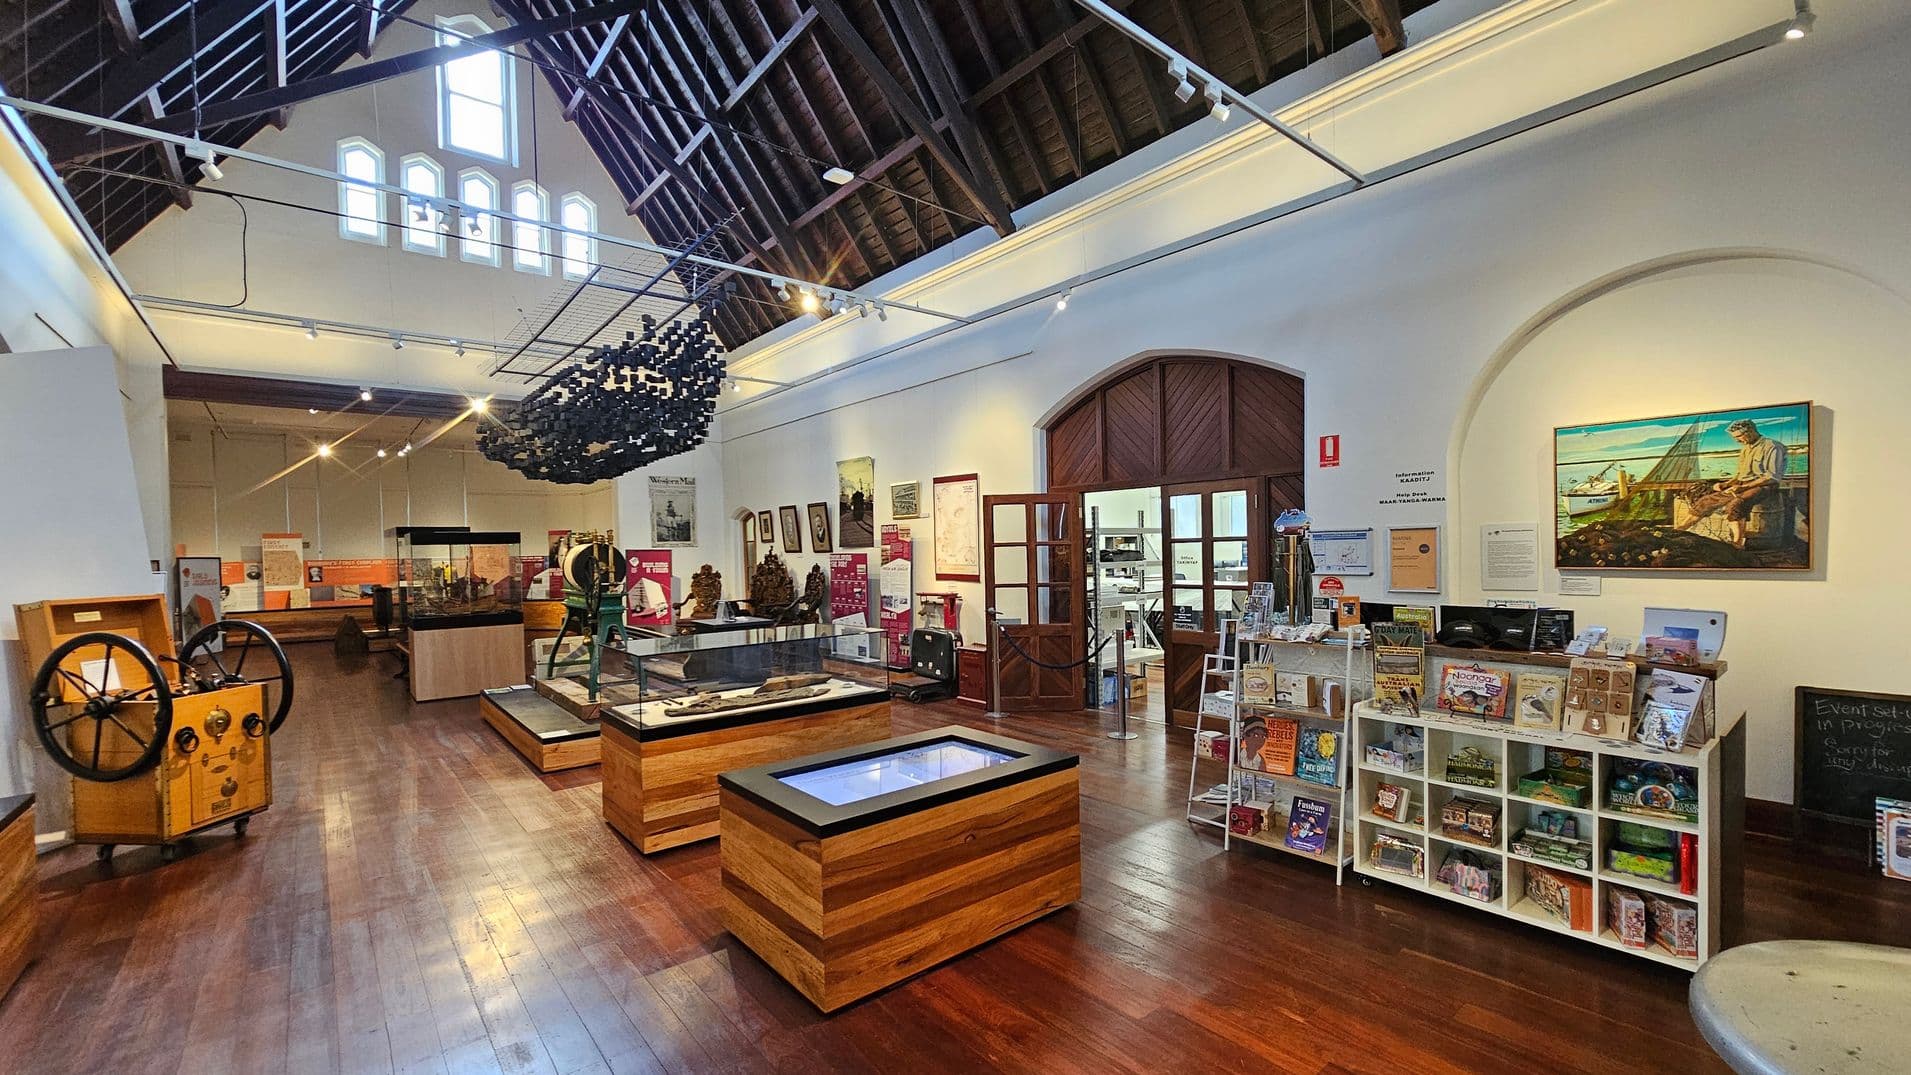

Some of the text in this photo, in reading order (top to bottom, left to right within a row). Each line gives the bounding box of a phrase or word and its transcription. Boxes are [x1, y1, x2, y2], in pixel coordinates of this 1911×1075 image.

[1398, 626, 1418, 634] MATE
[1453, 671, 1497, 684] Noongar
[1815, 699, 1866, 717] Event
